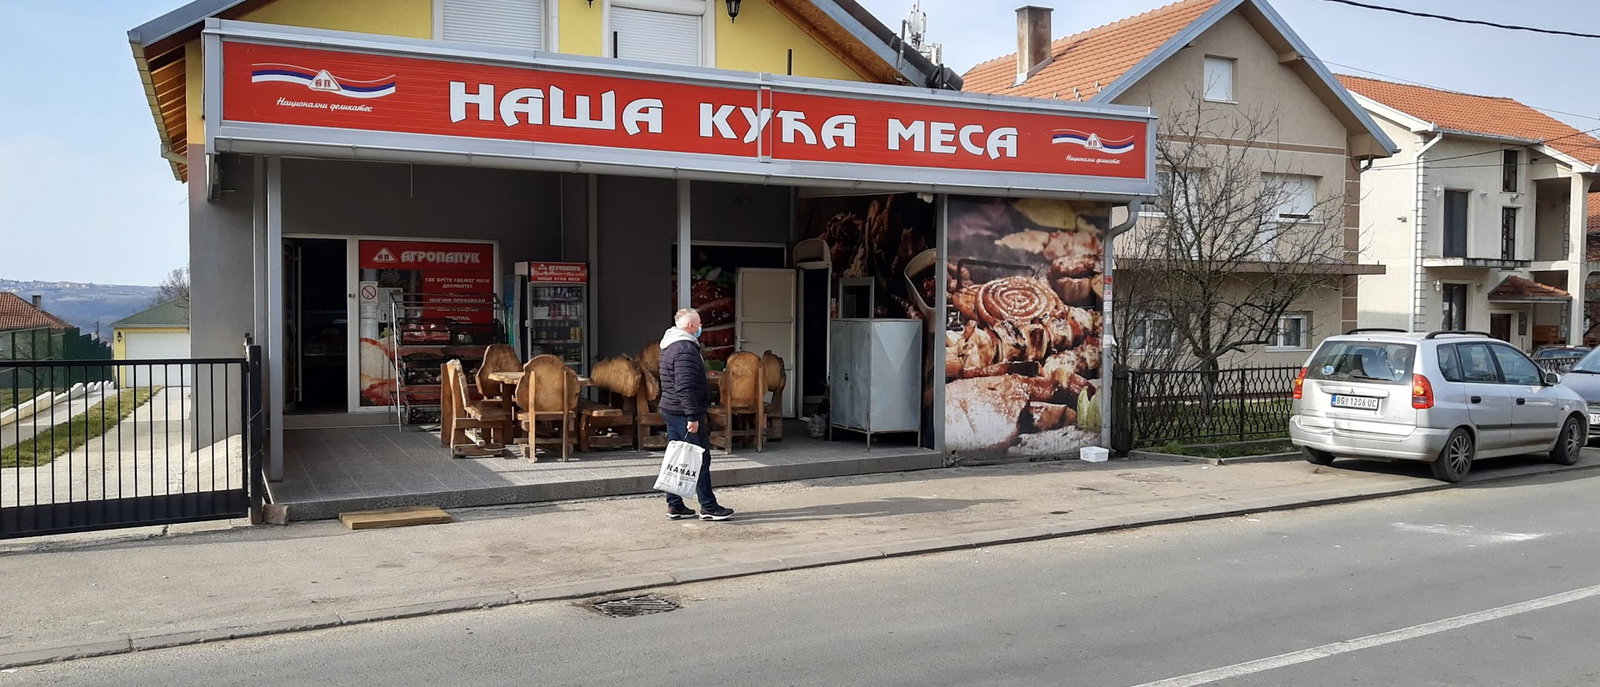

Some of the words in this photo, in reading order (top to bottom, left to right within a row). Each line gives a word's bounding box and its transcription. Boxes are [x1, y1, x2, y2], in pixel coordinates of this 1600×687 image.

[276, 96, 328, 110] Национални
[330, 102, 373, 113] деликатес
[449, 80, 664, 136] НАША
[699, 103, 857, 150] КУЋА
[887, 118, 1019, 160] МЕСА
[400, 250, 481, 264] АГРОПАПУК
